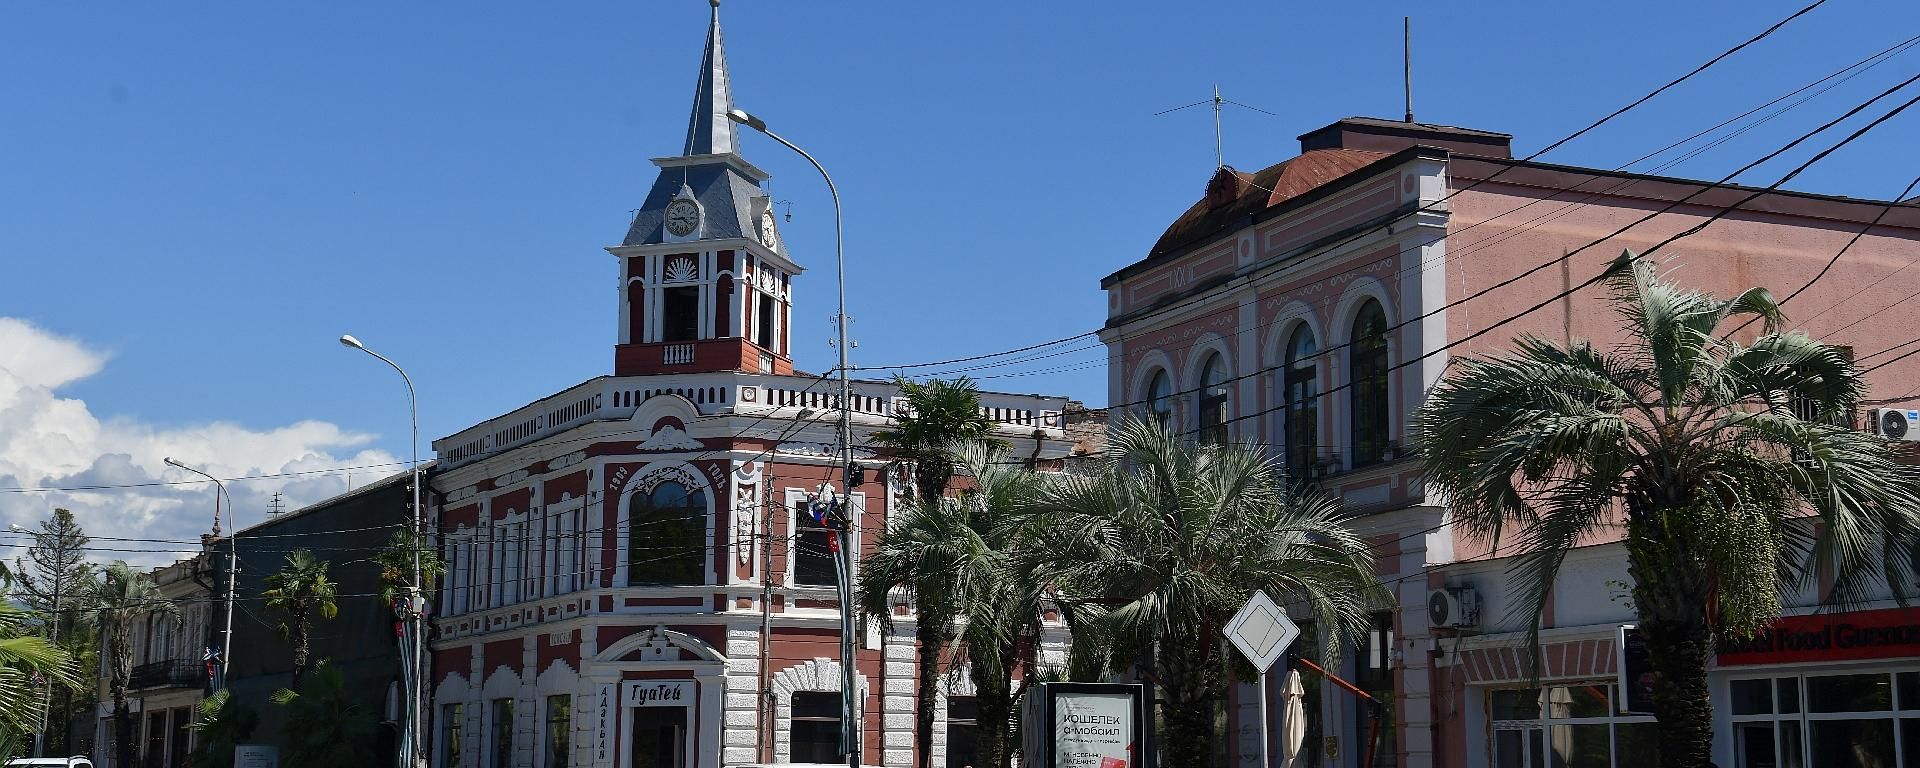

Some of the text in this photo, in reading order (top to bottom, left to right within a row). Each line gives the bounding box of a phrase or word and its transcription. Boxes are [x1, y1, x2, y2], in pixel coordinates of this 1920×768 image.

[609, 466, 628, 491] 1909
[1776, 624, 1831, 650] Food
[1063, 714, 1121, 725] КОШЕЛЕК
